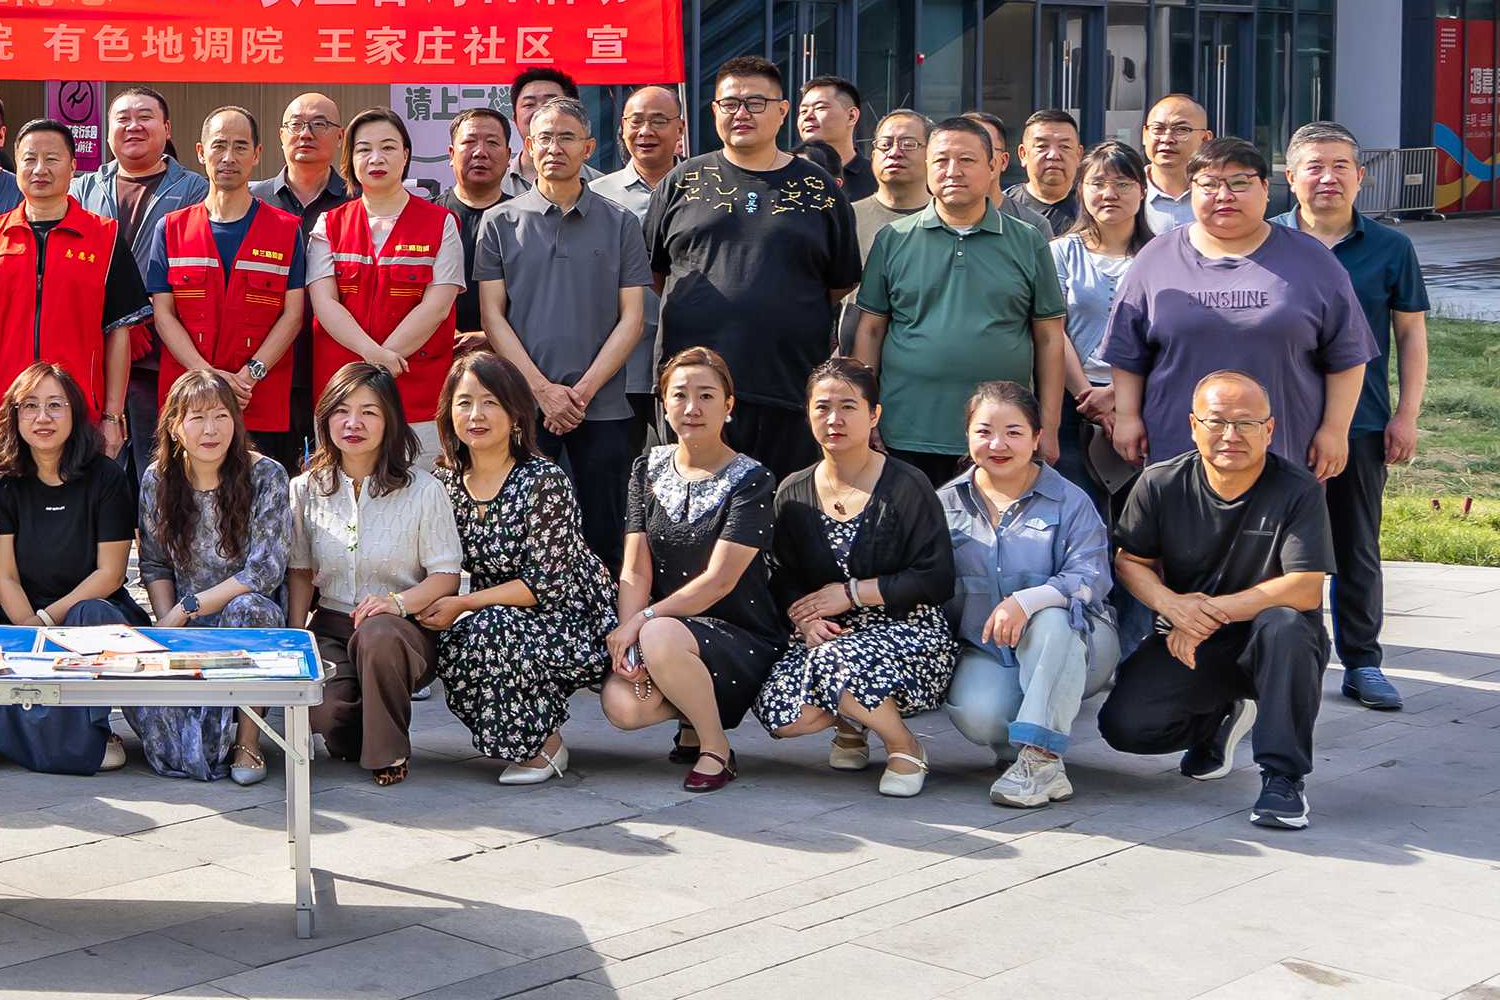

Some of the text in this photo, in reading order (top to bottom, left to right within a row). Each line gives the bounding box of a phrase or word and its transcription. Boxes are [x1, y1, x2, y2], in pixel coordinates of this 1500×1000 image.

[44, 23, 283, 64] 有色地调院
[314, 25, 554, 66] 王家庄社区
[586, 24, 628, 65] 宣
[1187, 290, 1270, 309] SUNSHINE
